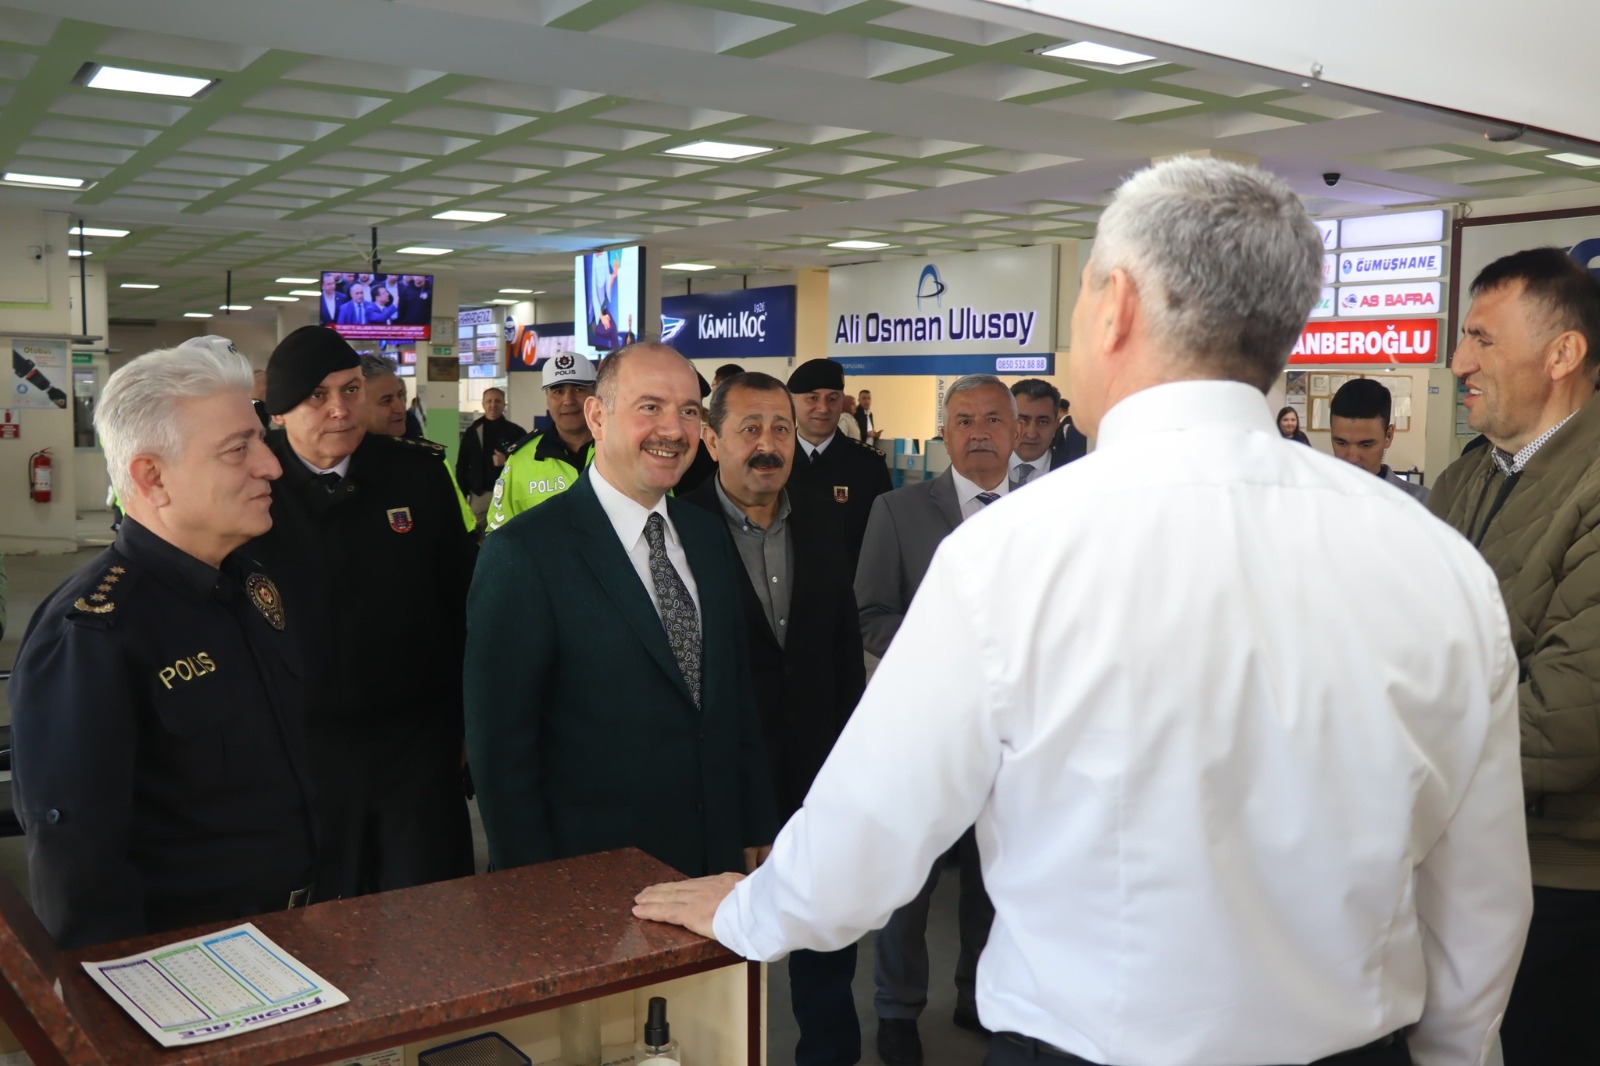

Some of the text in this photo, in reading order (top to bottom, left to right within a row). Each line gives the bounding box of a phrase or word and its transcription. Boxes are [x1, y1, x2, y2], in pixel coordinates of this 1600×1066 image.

[1360, 292, 1435, 308] AS BAFRA
[835, 307, 1035, 346] Ali Osman Ulusoy
[1291, 325, 1431, 355] ANBEROĞLU
[1014, 360, 1026, 369] 532
[1027, 360, 1035, 369] 88
[1036, 359, 1045, 369] 88
